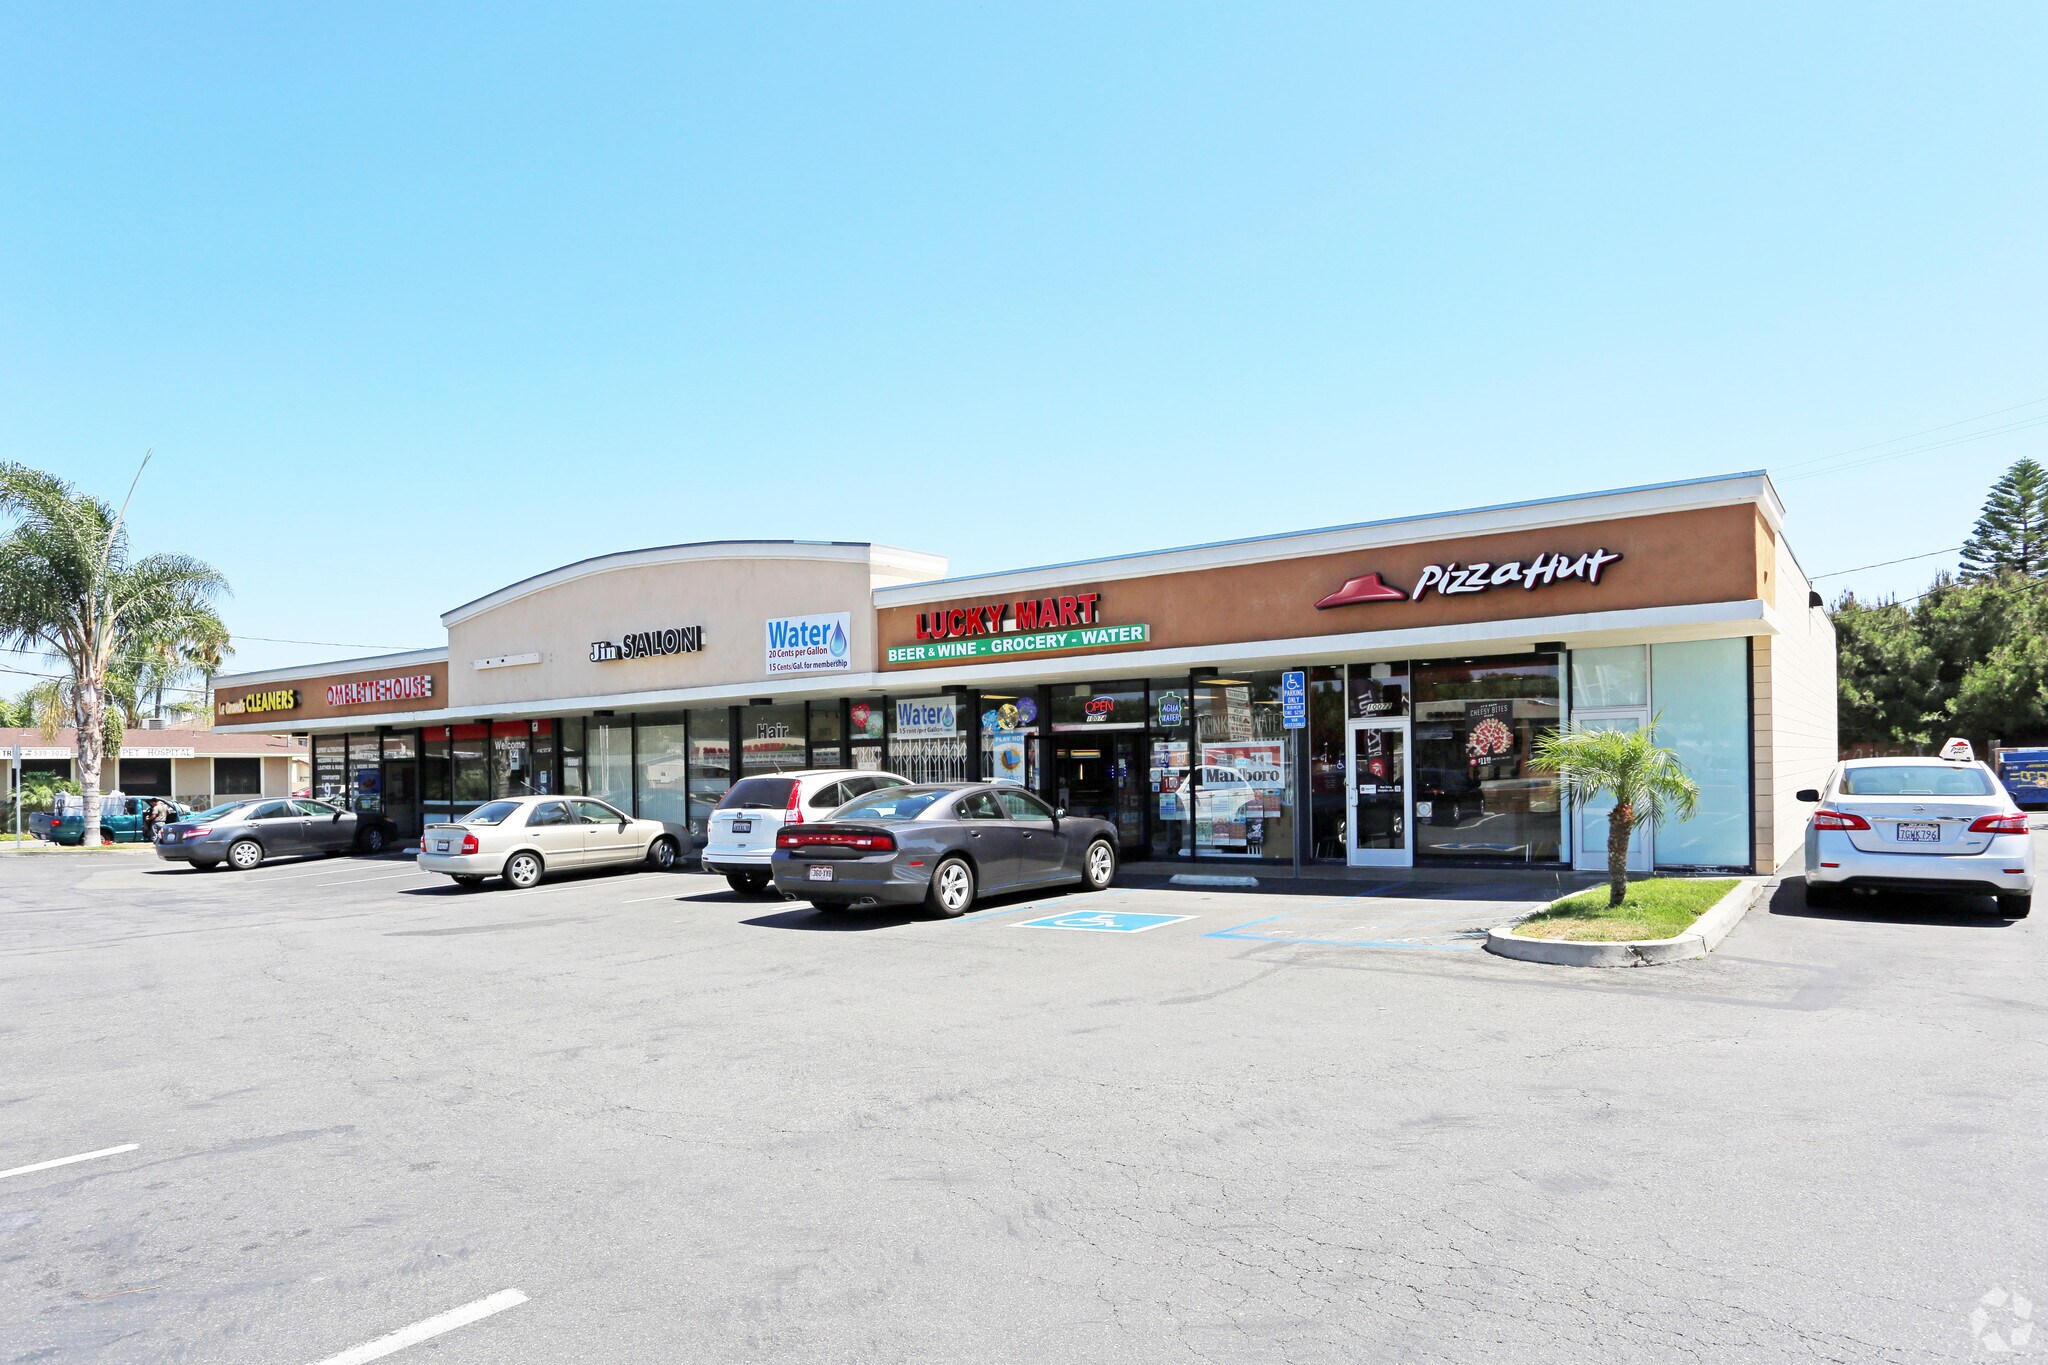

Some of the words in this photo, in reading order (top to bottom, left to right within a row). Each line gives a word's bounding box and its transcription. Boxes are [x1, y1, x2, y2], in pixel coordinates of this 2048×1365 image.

[915, 602, 1005, 640] LUCKY
[1014, 592, 1100, 630] MART
[768, 620, 831, 649] Water
[590, 641, 623, 662] Jin
[622, 626, 702, 660] SALON
[888, 647, 926, 662] BEER
[928, 647, 936, 657] &
[938, 641, 977, 657] WINE
[991, 633, 1069, 653] GROCERY
[1081, 626, 1144, 645] WATER
[768, 650, 777, 658] 20
[777, 648, 794, 658] Cents
[795, 649, 806, 658] per
[807, 646, 828, 656] Gallon
[769, 663, 776, 671] 15
[813, 659, 848, 669] membership
[326, 681, 384, 706] OMELETTE
[384, 675, 432, 700] HOUSE
[245, 689, 296, 713] CLEANERS
[1085, 700, 1115, 712] OPEN
[898, 703, 943, 725] Water
[1162, 704, 1179, 712] AGUA
[1470, 707, 1491, 717] CHEESY
[1491, 704, 1508, 713] BITES
[1161, 713, 1180, 721] WATER
[757, 723, 789, 739] Hair
[495, 740, 526, 750] Welcome
[122, 748, 140, 757] PET
[147, 748, 192, 757] HOSPITAL
[1206, 769, 1280, 783] Marlboro
[1900, 829, 1937, 840] 7GWK796
